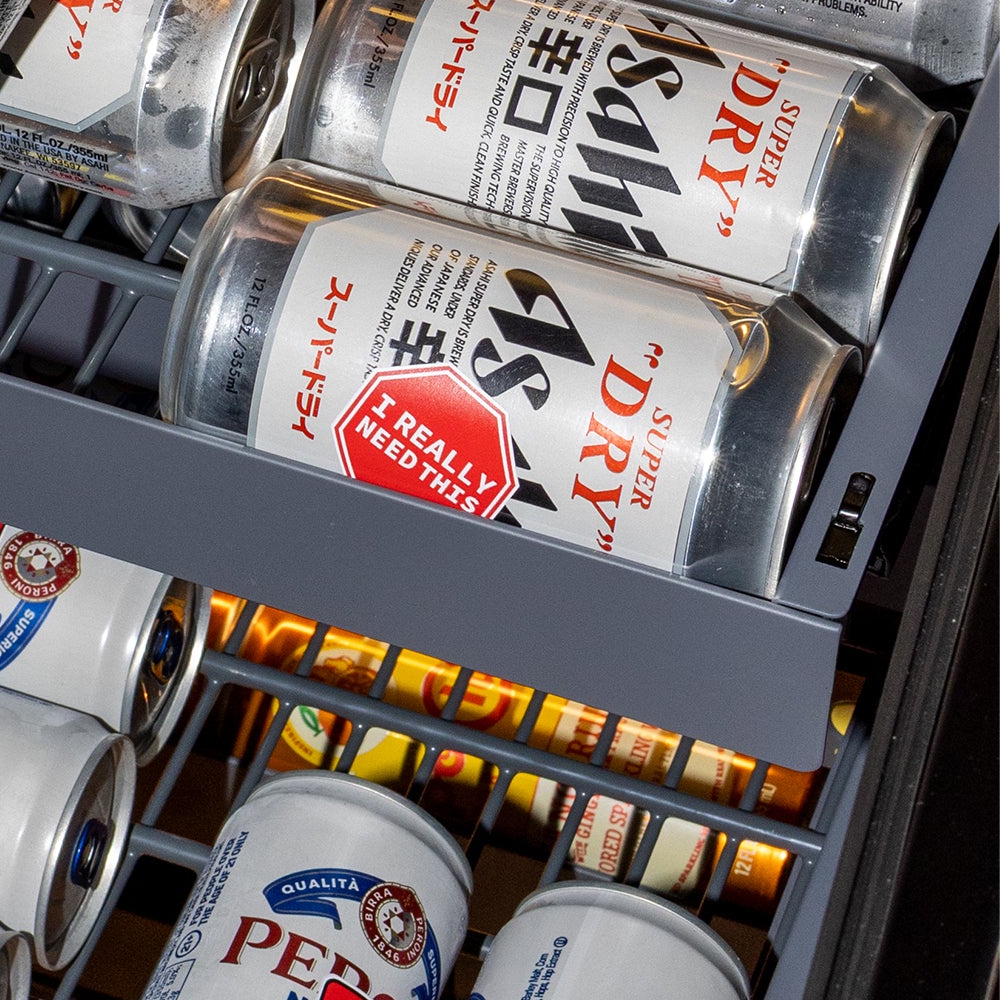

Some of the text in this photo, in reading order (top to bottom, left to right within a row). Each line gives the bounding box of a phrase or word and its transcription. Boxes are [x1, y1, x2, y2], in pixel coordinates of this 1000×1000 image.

[504, 27, 584, 135] 辛口
[574, 71, 588, 95] WITH
[560, 93, 581, 144] PRECISION
[560, 9, 725, 257] Asahi
[554, 142, 566, 157] TO
[755, 99, 801, 189] SUPER
[549, 159, 562, 186] HIGH
[251, 277, 267, 292] 12
[291, 276, 353, 440] スーパードライ
[355, 416, 480, 513] NEED THIS
[372, 392, 497, 495] I REALLY
[630, 407, 673, 510] SUPER
[3, 538, 23, 570] 1846
[11, 580, 56, 597] PERONI
[189, 838, 236, 927] FOR PEOPLE OVER
[198, 905, 214, 928] THE
[209, 884, 223, 906] AGE
[219, 872, 230, 888] OF
[231, 831, 249, 857] ONLY
[282, 878, 359, 894] QUALITÀ
[364, 888, 392, 921] BIRRA
[371, 934, 400, 962] 1846
[405, 917, 424, 961] PERONI
